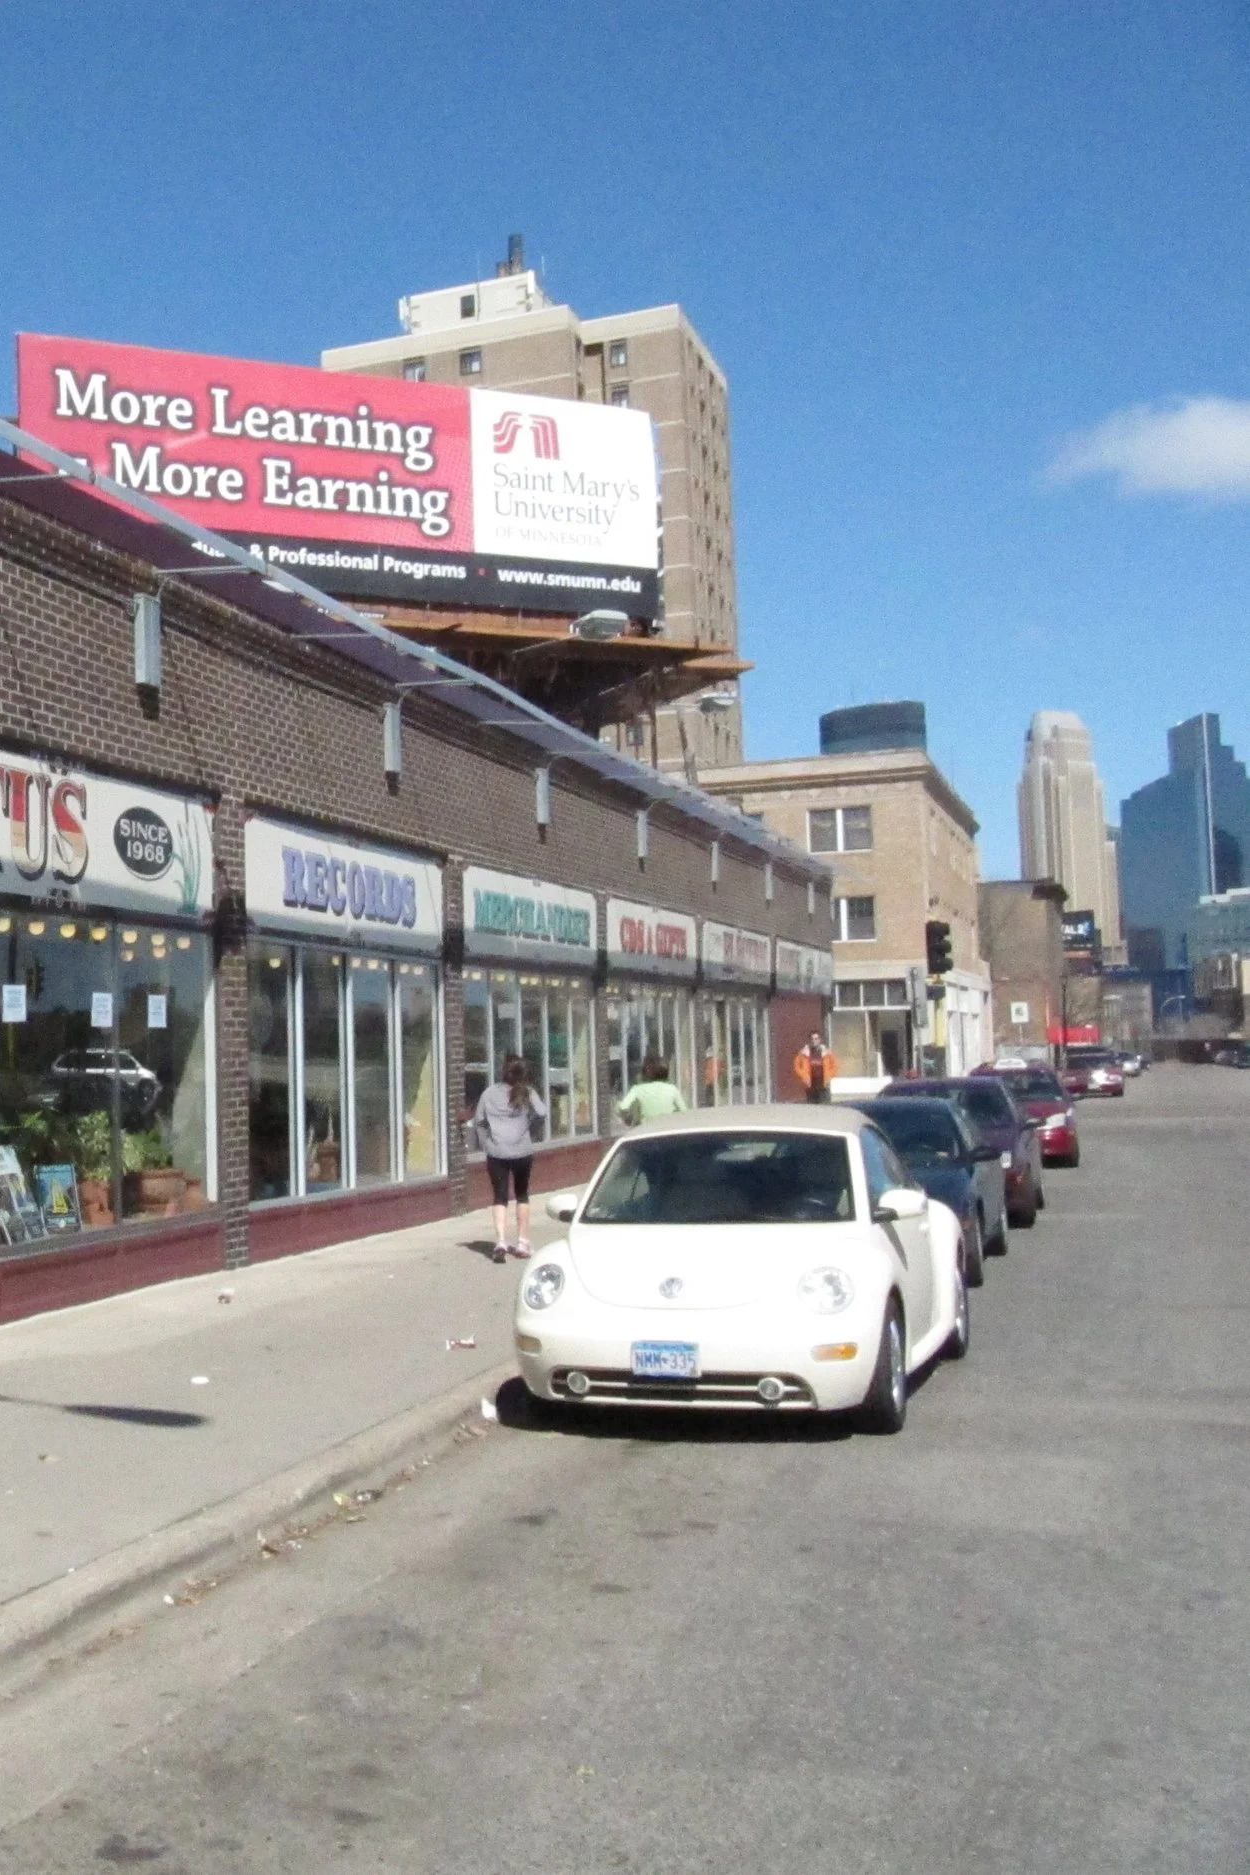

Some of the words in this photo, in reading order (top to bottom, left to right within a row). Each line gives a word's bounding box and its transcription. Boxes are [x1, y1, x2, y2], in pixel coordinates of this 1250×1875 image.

[55, 368, 193, 430] More
[211, 388, 434, 471] Learning
[111, 442, 243, 500] More
[262, 458, 450, 536] Earning
[493, 462, 554, 493] Saint
[562, 470, 640, 507] Mary's
[494, 491, 618, 535] University
[495, 526, 515, 539] OF
[268, 545, 379, 571] Professional
[383, 555, 467, 580] Programs
[497, 567, 642, 593] www.smumn.edu
[120, 818, 168, 843] SINCE
[127, 840, 165, 864] 1968
[282, 845, 417, 929] RECORDS
